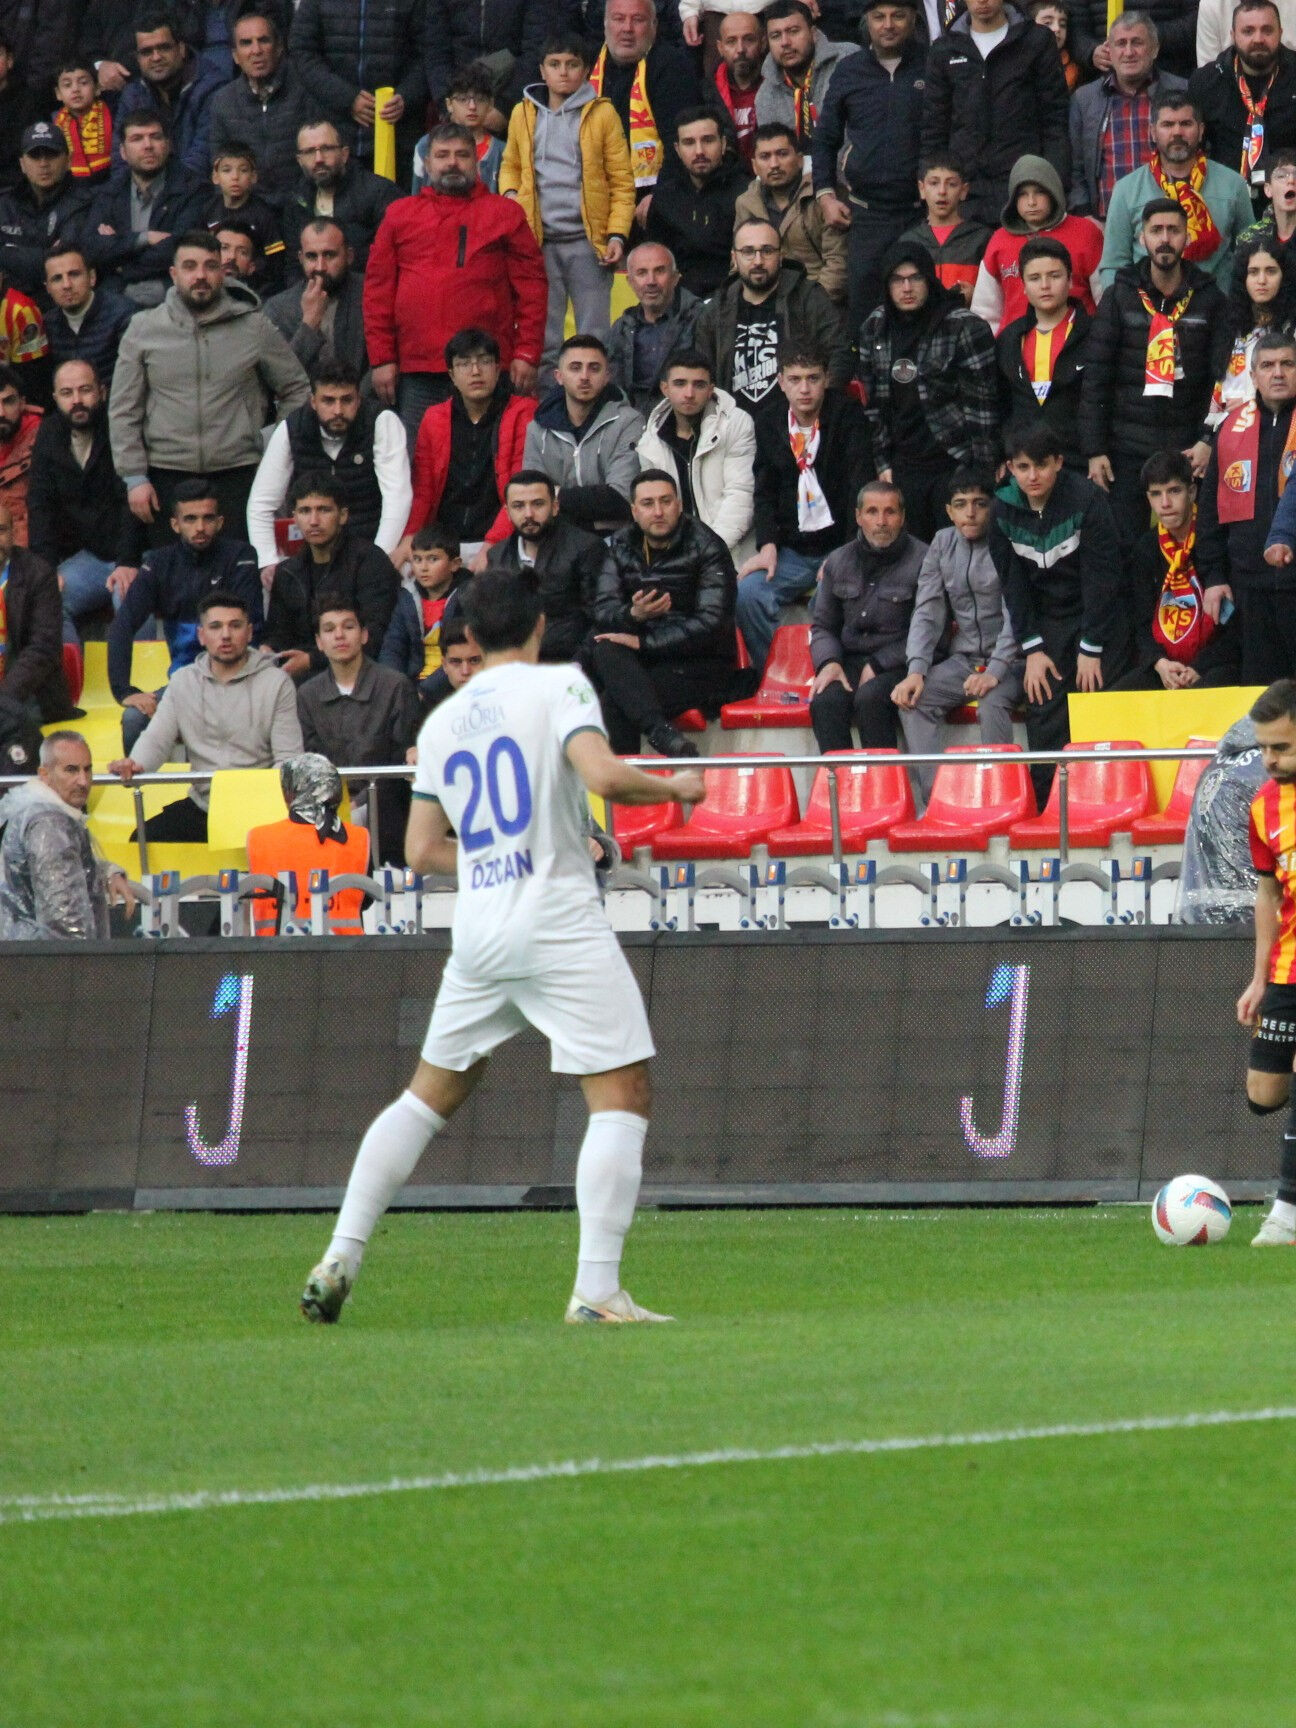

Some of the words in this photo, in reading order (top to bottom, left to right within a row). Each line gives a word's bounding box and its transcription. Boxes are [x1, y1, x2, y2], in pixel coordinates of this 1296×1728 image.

[1163, 608, 1192, 627] KS
[444, 736, 532, 853] 20
[471, 849, 534, 890] ÖZCAN
